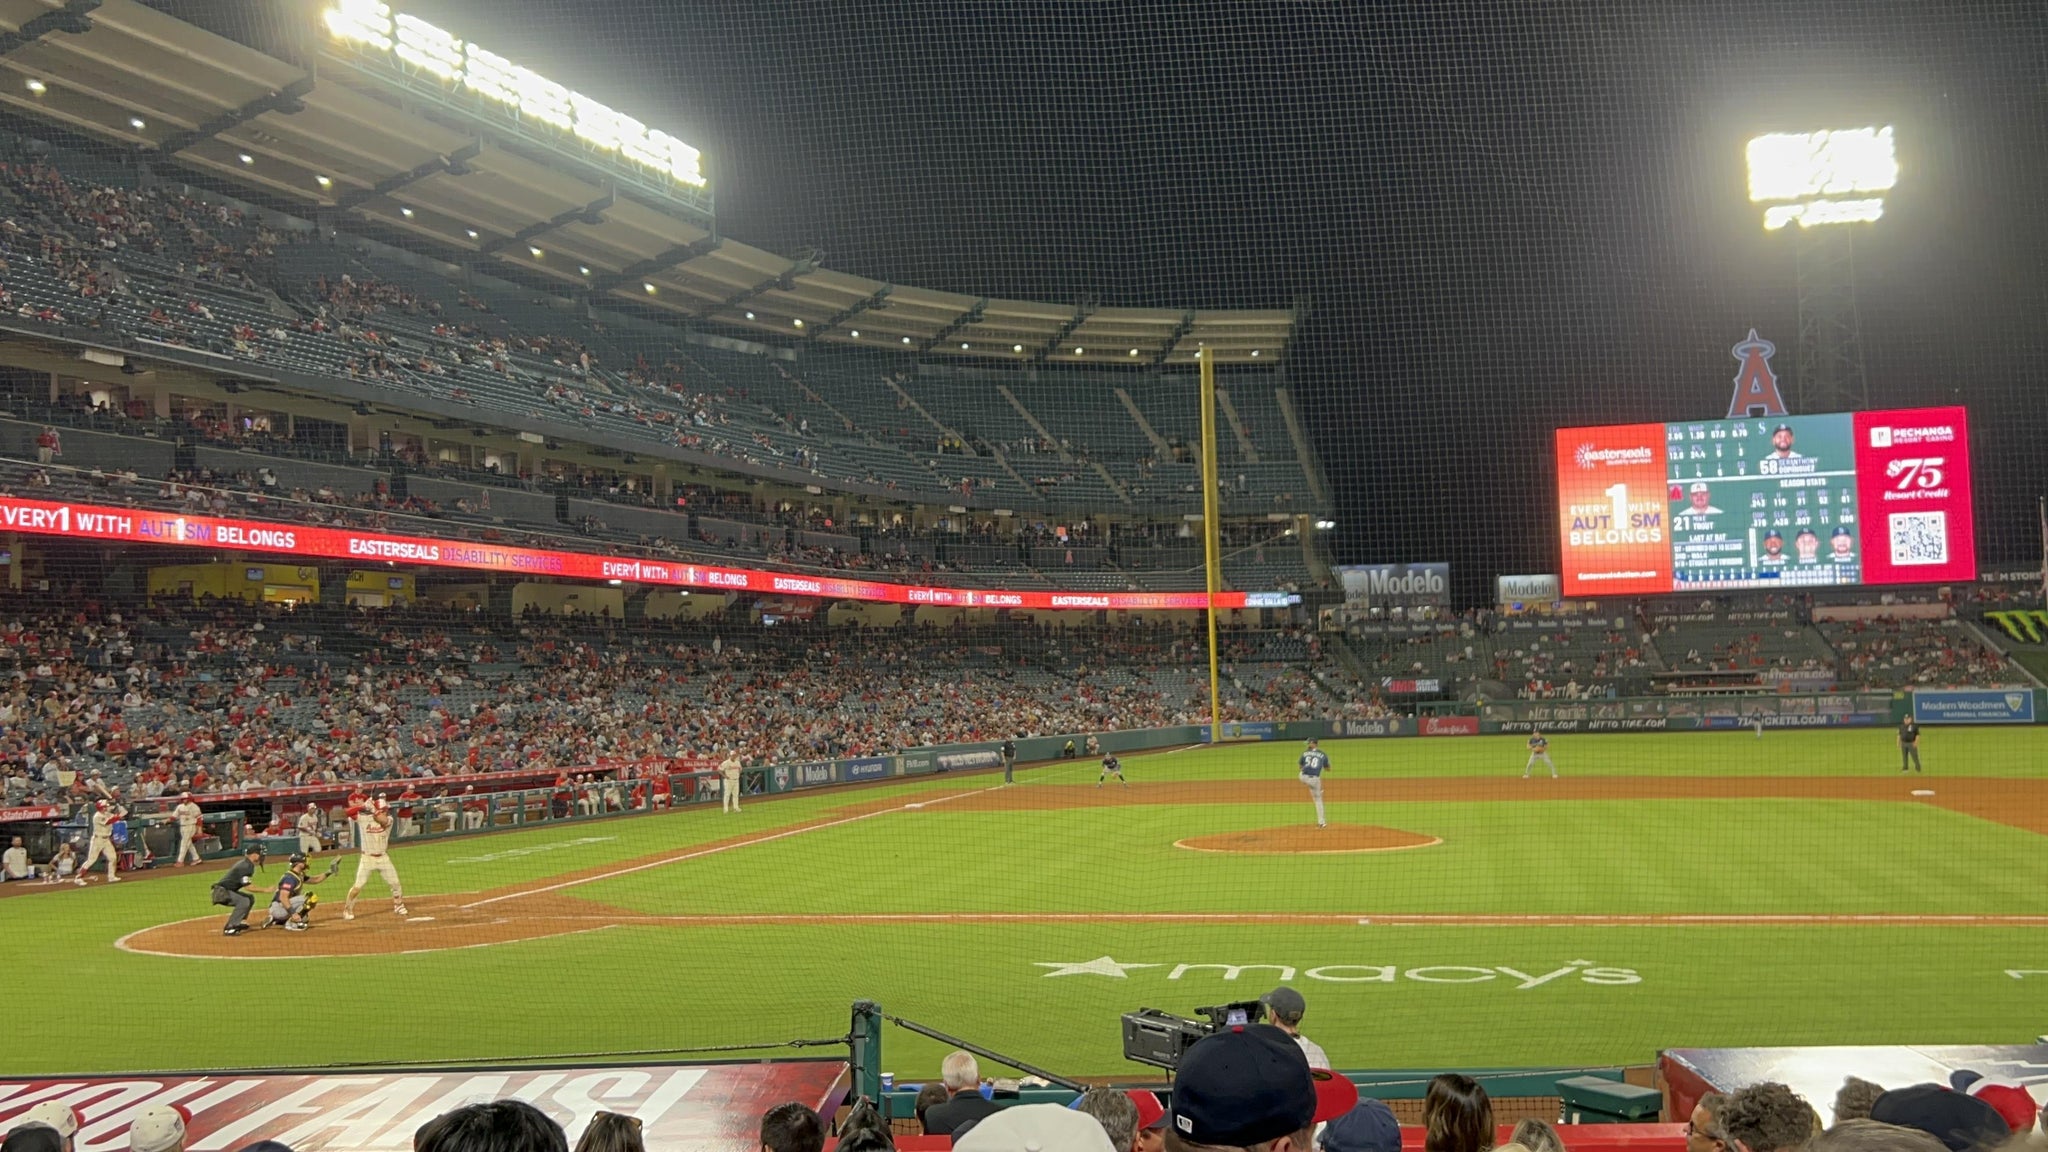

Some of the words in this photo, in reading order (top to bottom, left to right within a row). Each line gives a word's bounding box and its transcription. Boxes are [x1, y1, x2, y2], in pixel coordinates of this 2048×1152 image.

[1893, 426, 1953, 438] PECHANGA
[1584, 446, 1651, 461] easterseals
[1760, 460, 1778, 475] 58
[1886, 457, 1944, 489] $75
[1884, 490, 1916, 500] Resort
[1917, 488, 1948, 498] Credit
[1570, 504, 1608, 516] EVERY
[1628, 502, 1660, 513] WITH
[0, 505, 70, 531] VERY1
[77, 511, 131, 534] WITH
[139, 518, 211, 541] AUT1SM
[216, 525, 296, 548] BELONGS
[1673, 516, 1689, 531] 21
[1693, 521, 1714, 530] TROUT
[1570, 528, 1661, 546] BELONGS
[350, 538, 439, 560] EASTERSEALS
[443, 548, 508, 566] DISABILITY
[511, 554, 562, 571] SERVICES
[603, 562, 640, 579] EVERY1
[642, 566, 668, 579] WITH
[708, 572, 748, 587] BELONGS
[1370, 568, 1443, 595] Modelo
[774, 578, 820, 593] EASTERSEALS
[1505, 581, 1551, 596] Modelo
[934, 592, 952, 601] WITH
[985, 594, 1022, 605] BELONGS
[1052, 596, 1109, 607] EASTERSEALS
[1922, 702, 1956, 711] Modern
[1958, 700, 2005, 710] Woodmen
[1346, 721, 1384, 735] Modelo
[1501, 720, 1531, 731] NITTO
[1533, 720, 1578, 732] TIRE.COM
[1588, 720, 1618, 730] NITTO
[1621, 719, 1667, 729] TIRE.COM
[860, 763, 883, 773] HYUNDAI
[1305, 756, 1319, 768] 58
[805, 765, 829, 781] Modelo
